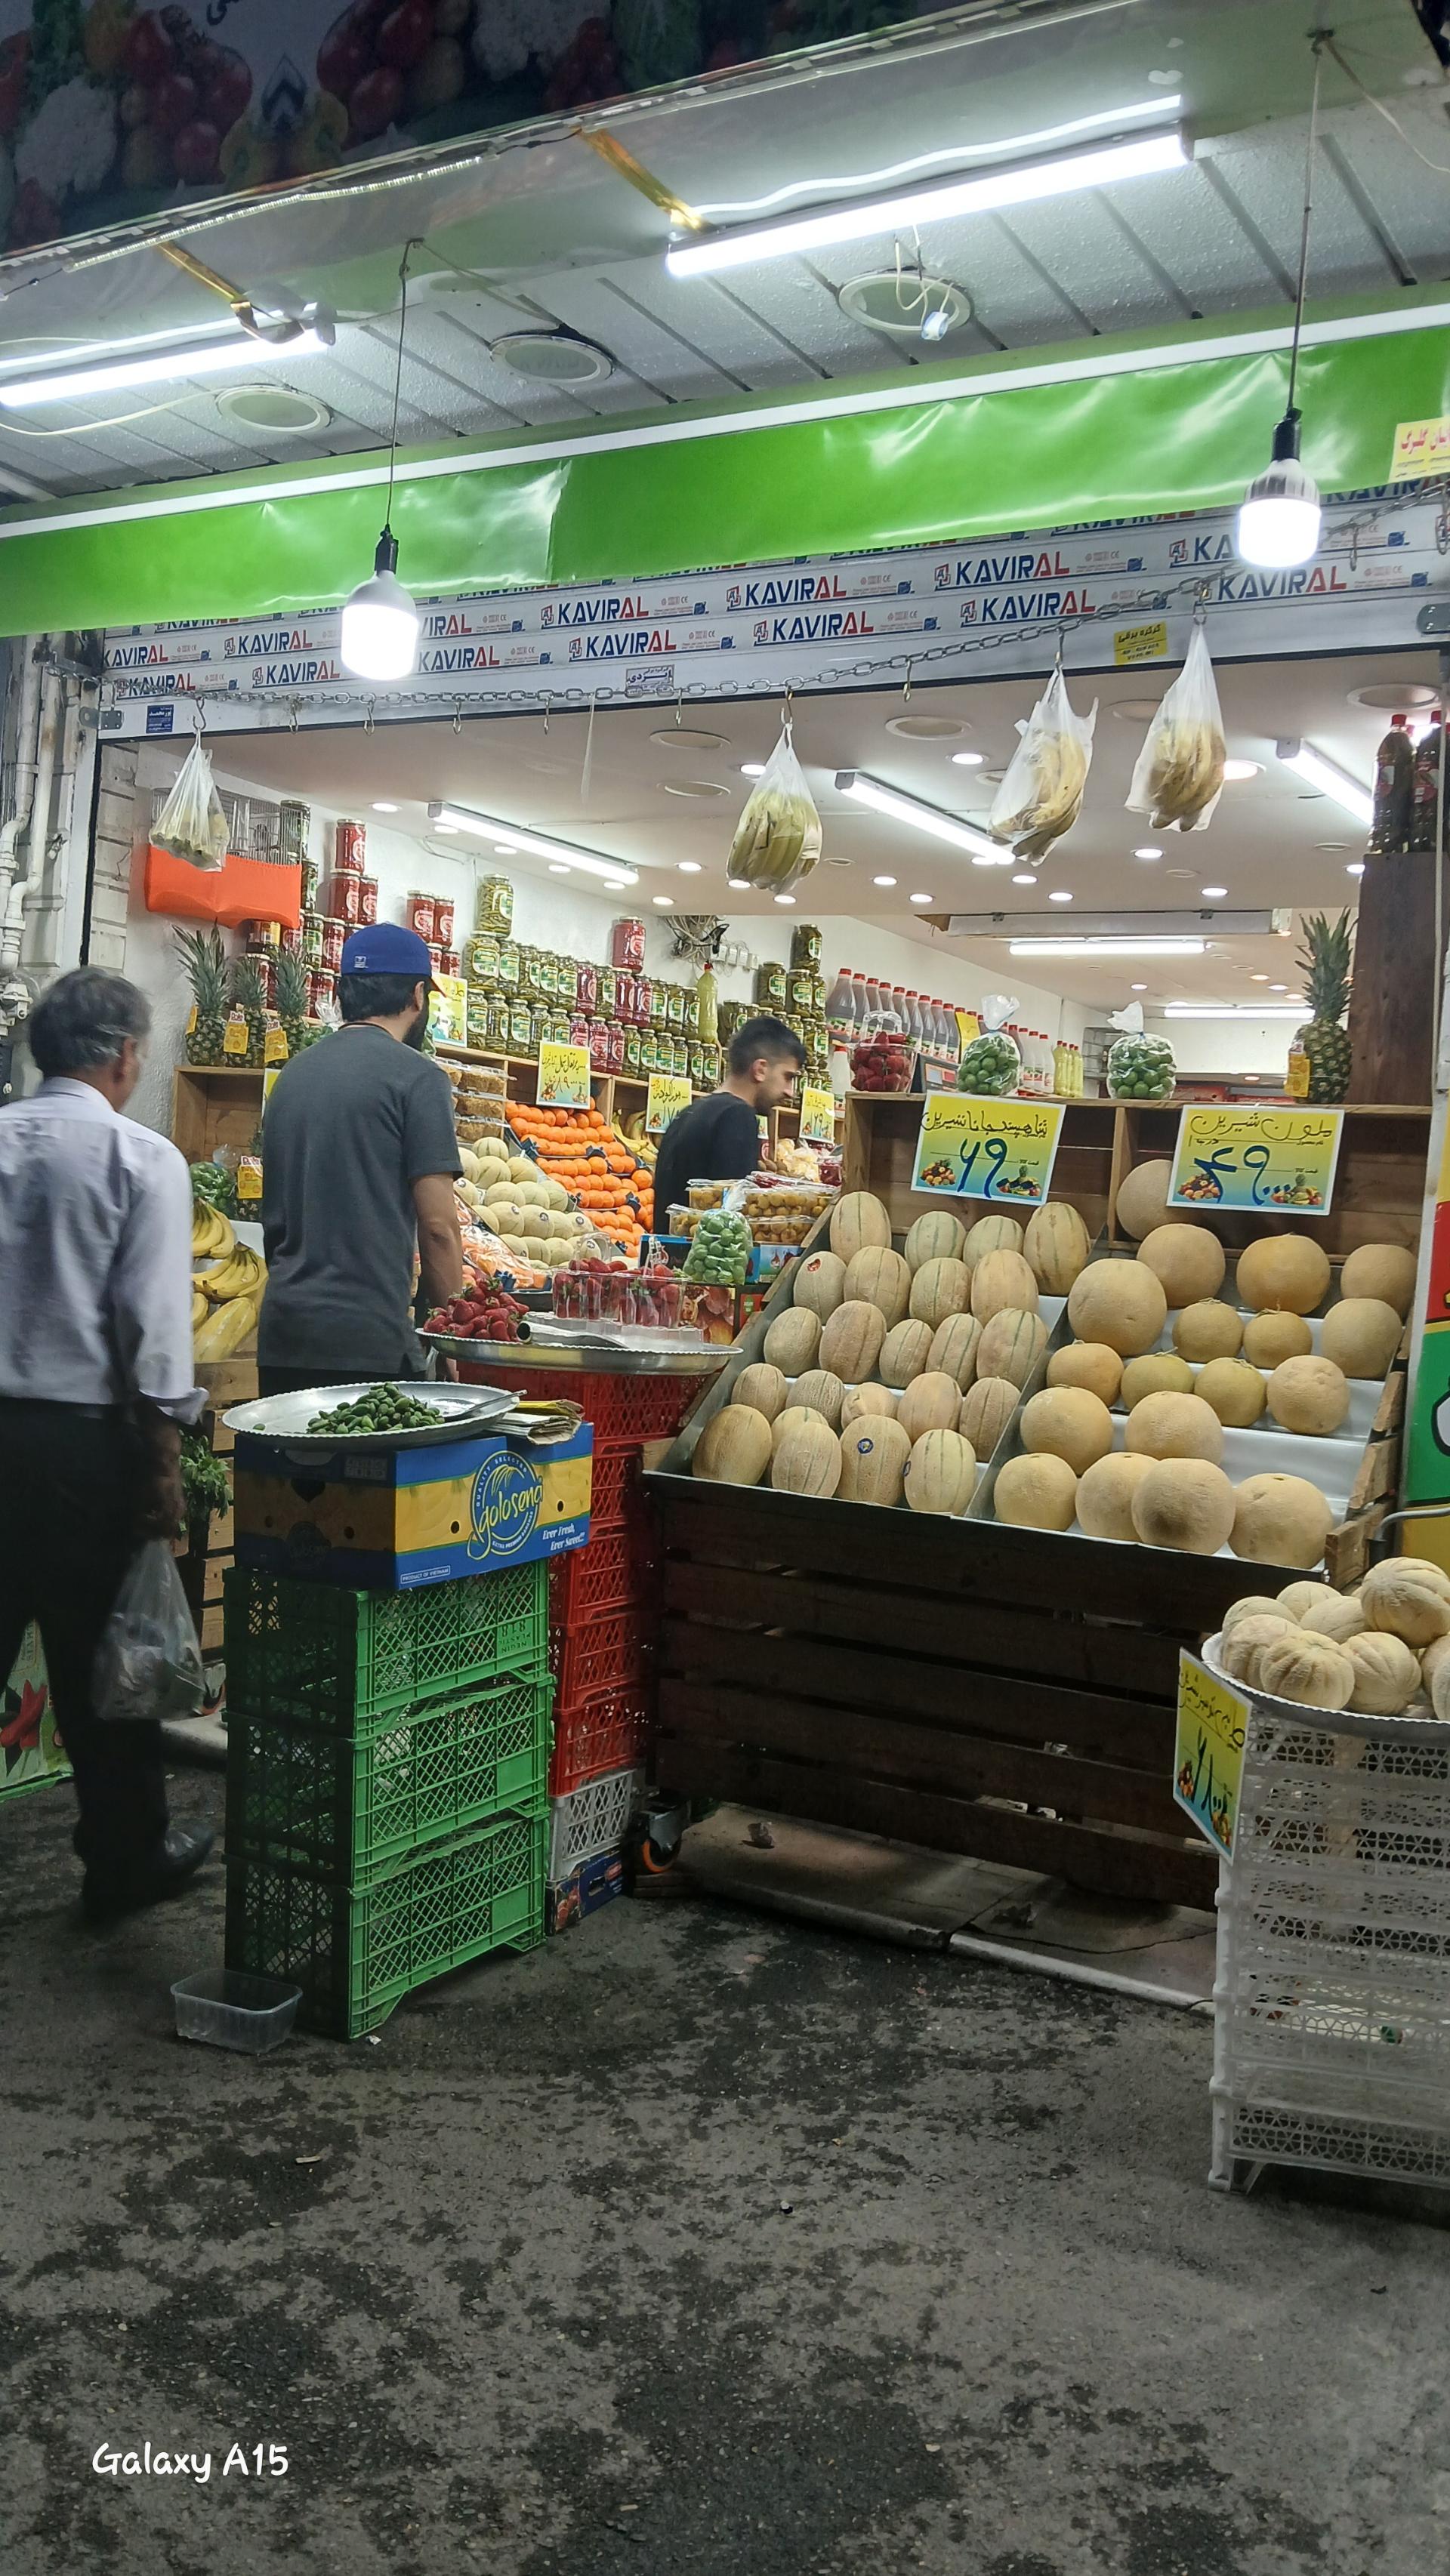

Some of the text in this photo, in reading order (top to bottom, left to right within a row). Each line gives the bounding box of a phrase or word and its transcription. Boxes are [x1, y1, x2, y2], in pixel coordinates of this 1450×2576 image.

[956, 551, 1069, 585] KAVIRAL
[745, 575, 847, 606] KAVIRAL
[1217, 566, 1347, 601] KAVIRAL
[558, 596, 649, 624] KAVIRAL
[981, 589, 1096, 622] KAVIRAL
[772, 611, 874, 642] KAVIRAL
[103, 644, 168, 667] KAVIRAL
[238, 630, 313, 655] KAVIRAL
[586, 630, 677, 658] KAVIRAL
[266, 660, 341, 685] KAVIRAL
[418, 646, 501, 672] KAVIRAL
[476, 1456, 527, 1507] QUALITY SELECTED
[403, 1573, 422, 1582] PRODUCT
[430, 1568, 449, 1576] VIETNAM
